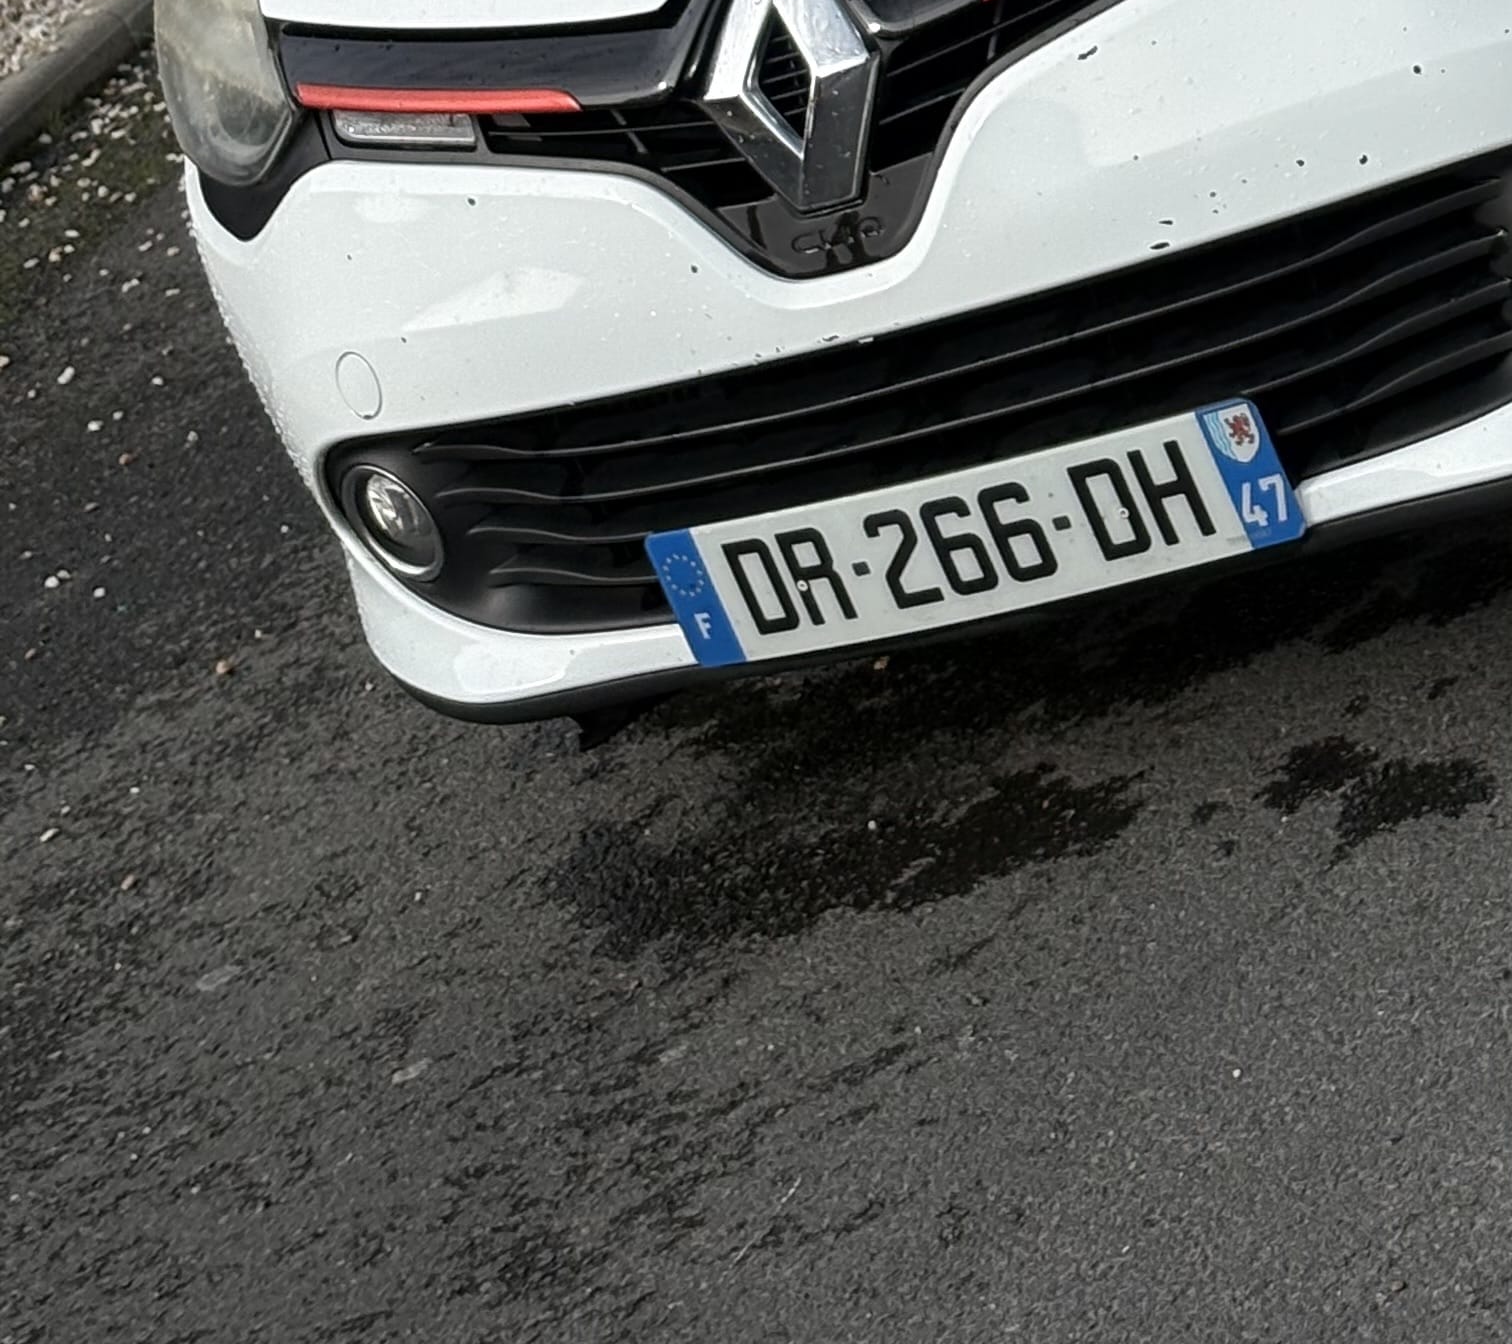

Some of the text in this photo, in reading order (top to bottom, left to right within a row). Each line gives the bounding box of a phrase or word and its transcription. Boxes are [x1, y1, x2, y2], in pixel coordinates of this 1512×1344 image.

[1241, 473, 1288, 527] 47
[721, 440, 1216, 635] DR-266-DH
[693, 612, 712, 639] F
